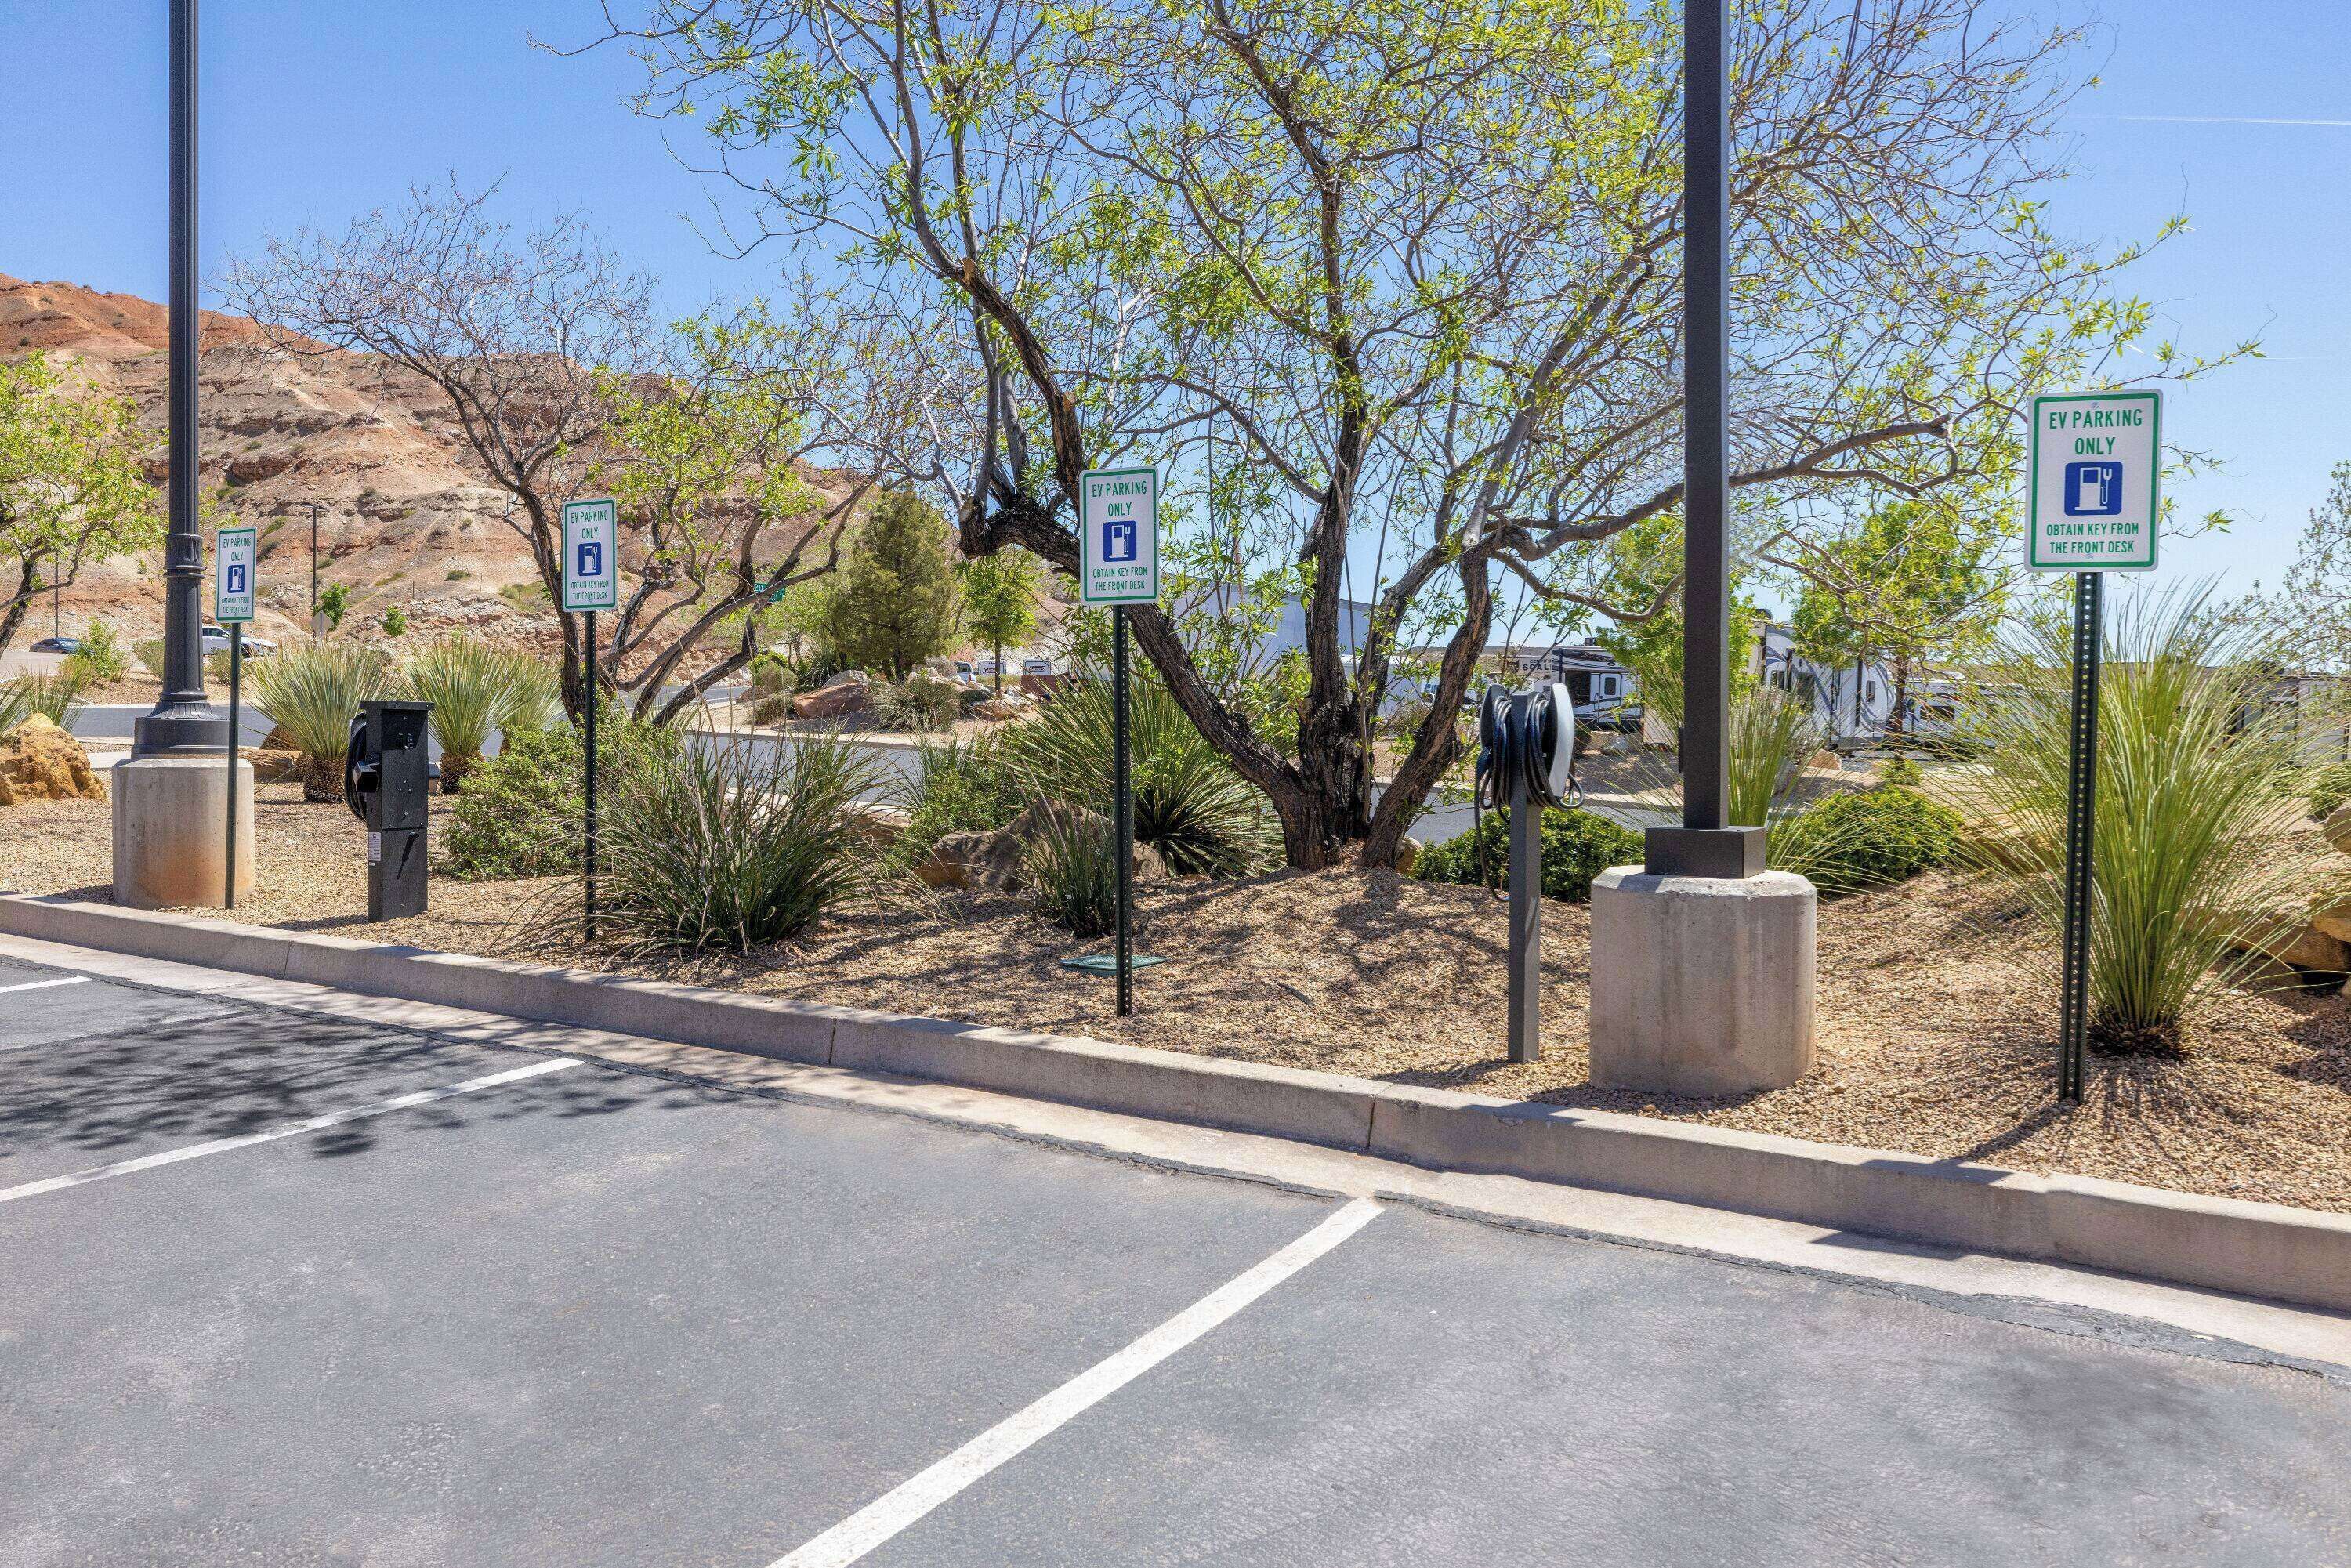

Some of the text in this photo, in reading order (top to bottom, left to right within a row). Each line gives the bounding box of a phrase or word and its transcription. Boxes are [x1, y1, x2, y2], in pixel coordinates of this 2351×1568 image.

[2050, 409, 2142, 429] EV PARKING
[2075, 437, 2116, 455] ONLY
[1092, 480, 1147, 497] EV PARKING
[1108, 502, 1132, 516] ONLY
[571, 510, 608, 523] EV PARKING
[581, 527, 599, 538] ONLY
[2046, 523, 2139, 536] OBTAIN KEY FROM
[223, 538, 251, 548] EV PARKING
[2050, 541, 2134, 553] THE FRONT DESK
[231, 552, 243, 561] ONLY
[1092, 567, 1147, 578] OBTAIN KEY FROM
[1096, 580, 1145, 591] THE FRONT DESK
